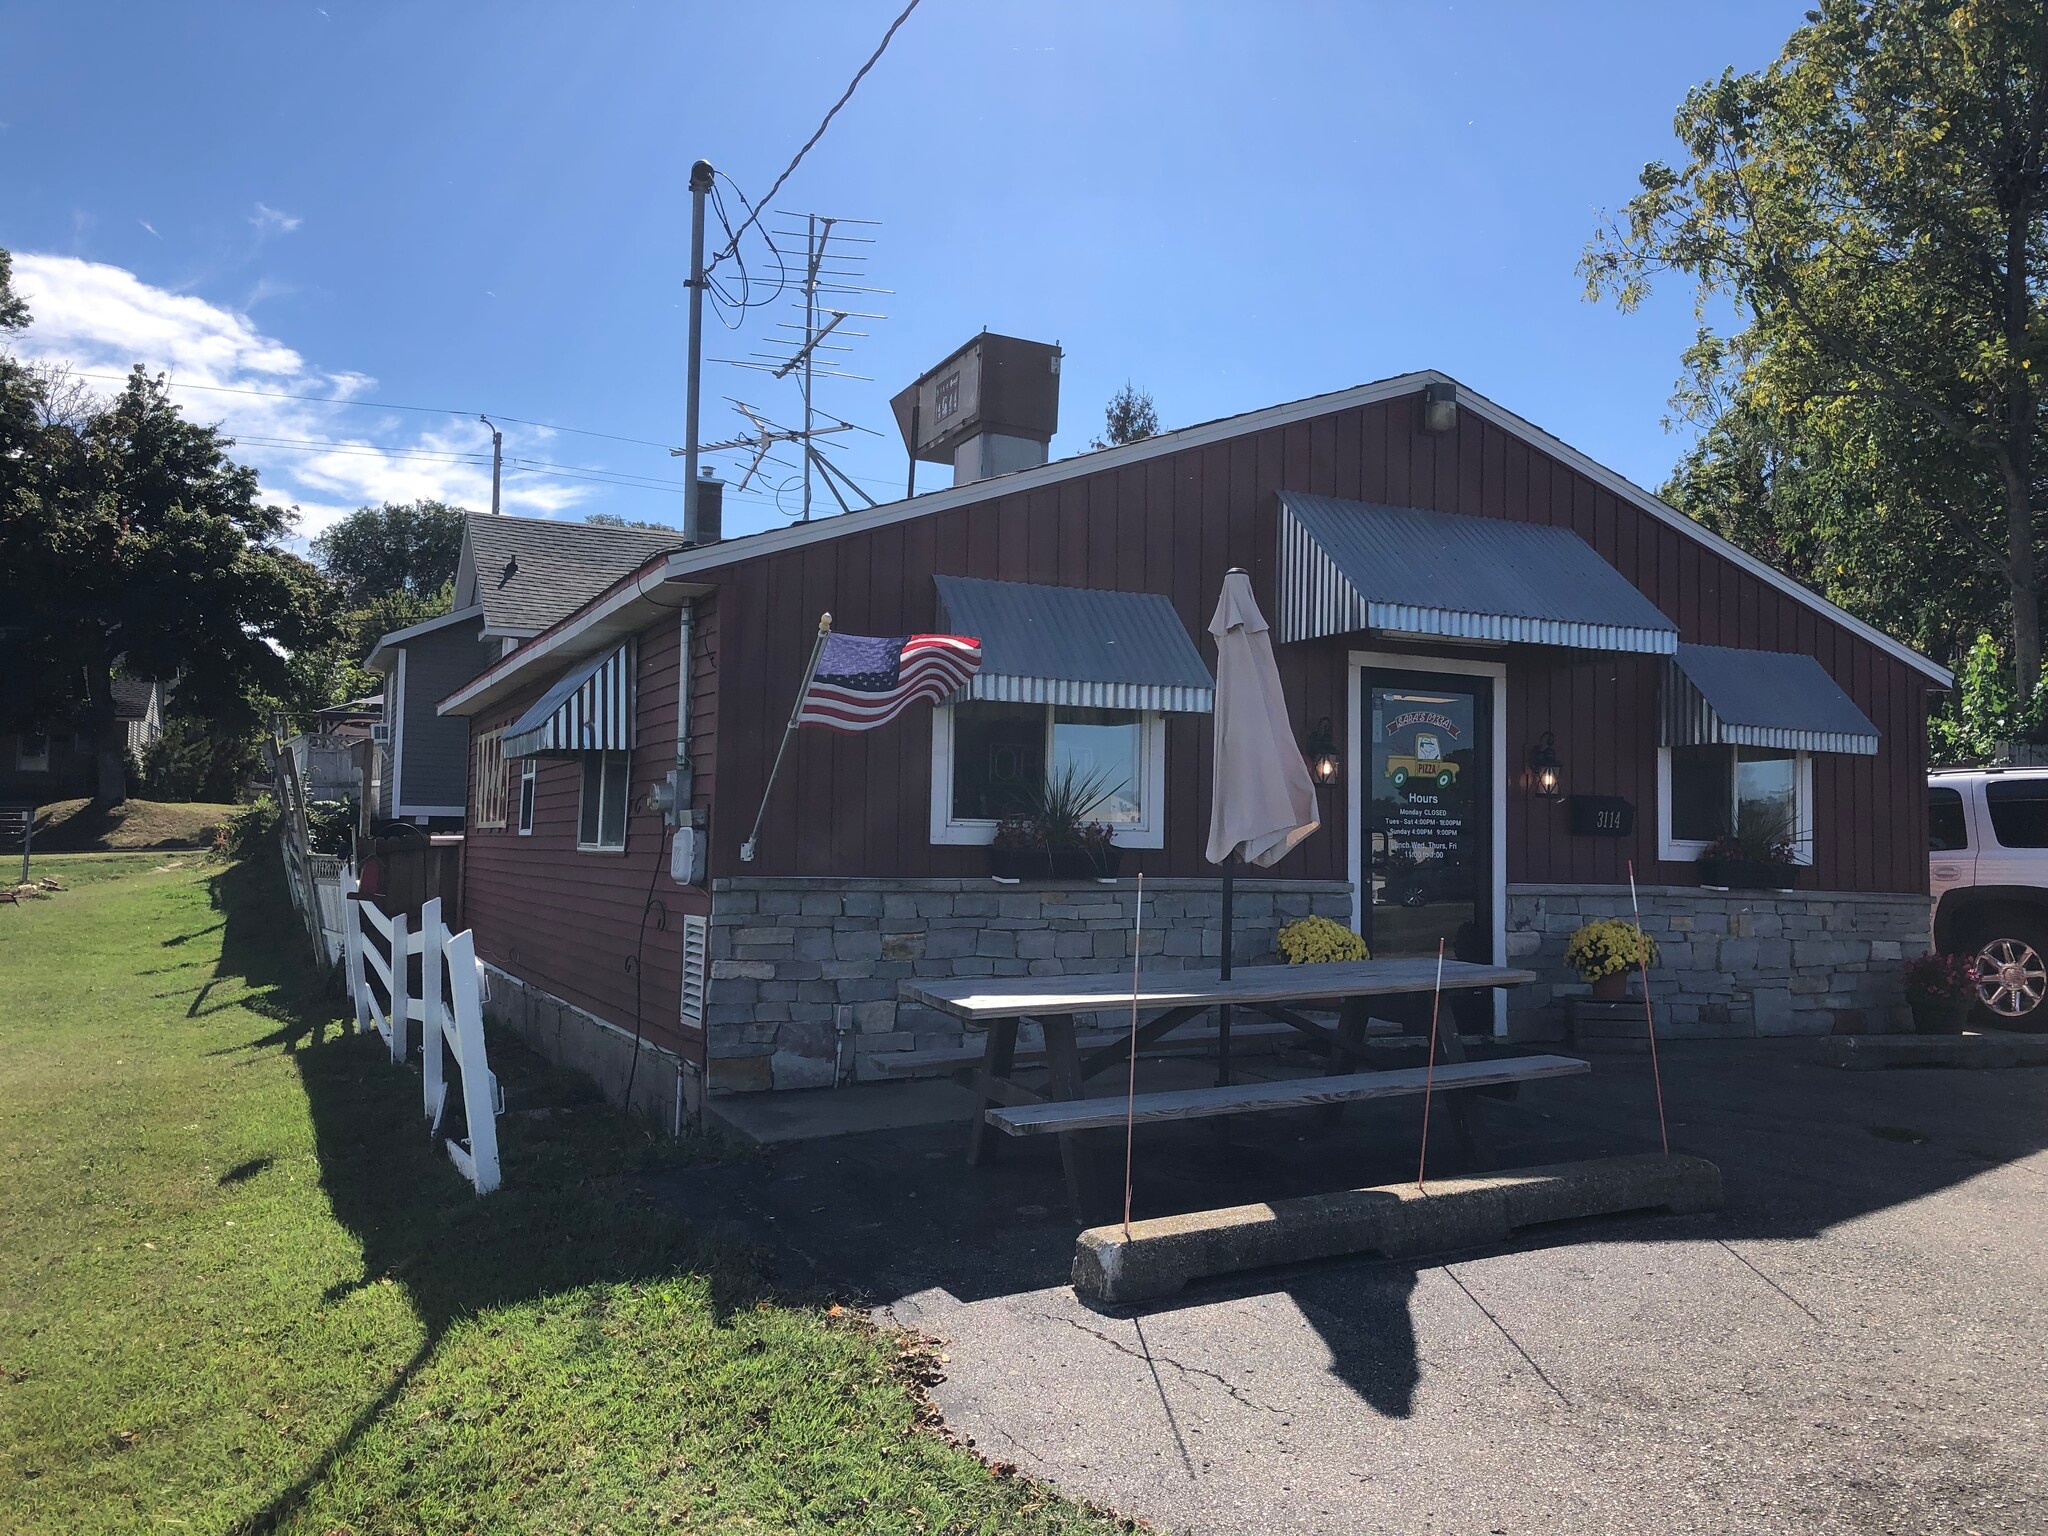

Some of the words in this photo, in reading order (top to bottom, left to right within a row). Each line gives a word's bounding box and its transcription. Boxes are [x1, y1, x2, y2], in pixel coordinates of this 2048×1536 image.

[1427, 713, 1450, 729] PIZZA
[1418, 763, 1436, 774] PIZZA
[1409, 792, 1439, 804] Hours
[1399, 808, 1423, 817] Monday
[1423, 809, 1447, 817] CLOSED
[1385, 817, 1400, 825] Tues
[1414, 818, 1436, 826] 4:00PM
[1596, 809, 1621, 829] 3114
[1389, 828, 1411, 836] Sunday
[1448, 842, 1457, 850] Fri
